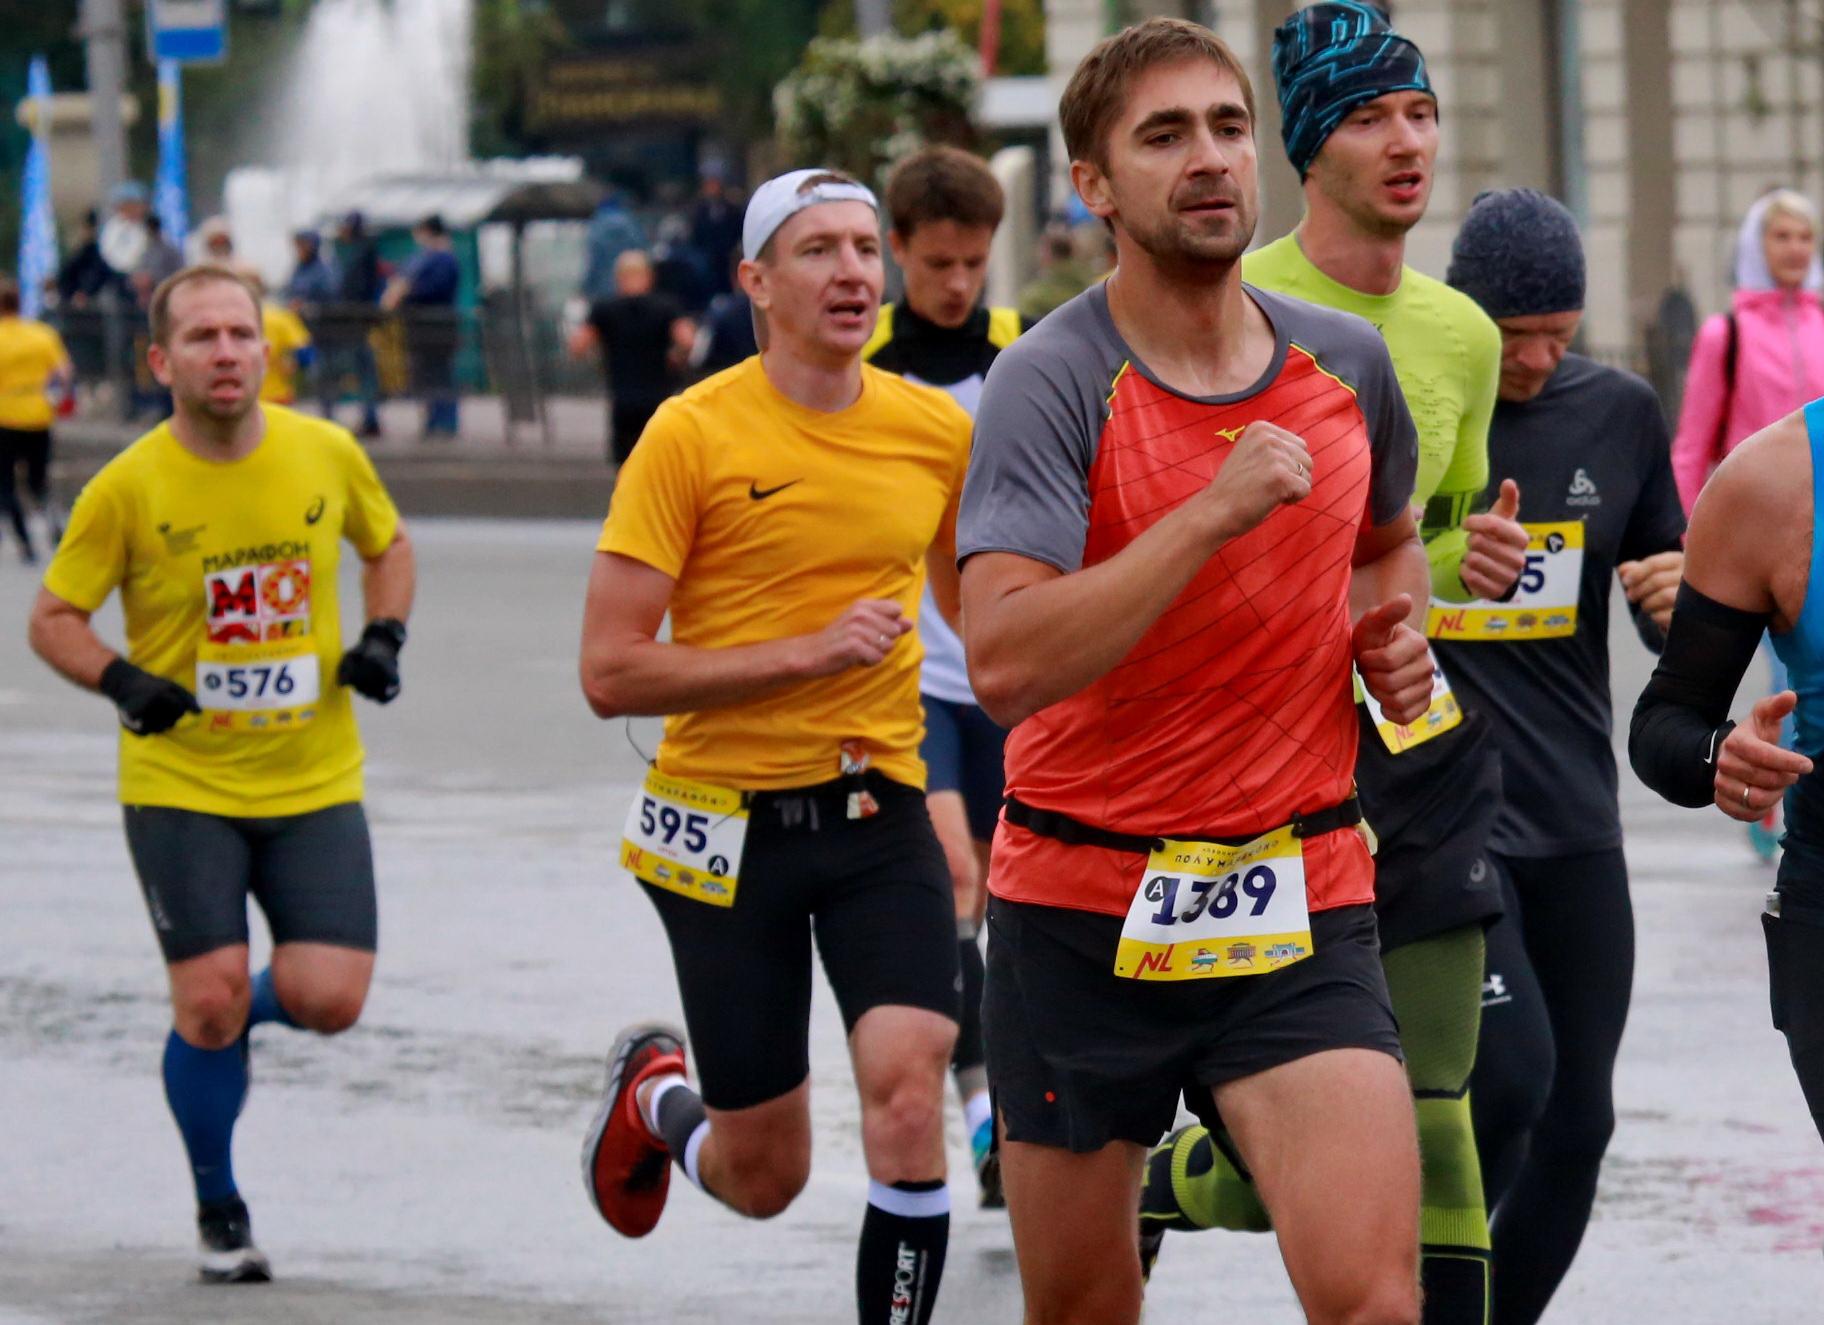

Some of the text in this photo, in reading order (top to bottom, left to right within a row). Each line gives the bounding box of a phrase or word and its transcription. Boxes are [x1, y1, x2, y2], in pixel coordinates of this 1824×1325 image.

[203, 541, 309, 572] МАРАФОН
[1435, 609, 1466, 639] NL
[227, 664, 294, 698] 576
[640, 796, 708, 853] 595
[1151, 865, 1277, 926] 1389
[1133, 943, 1175, 979] NL
